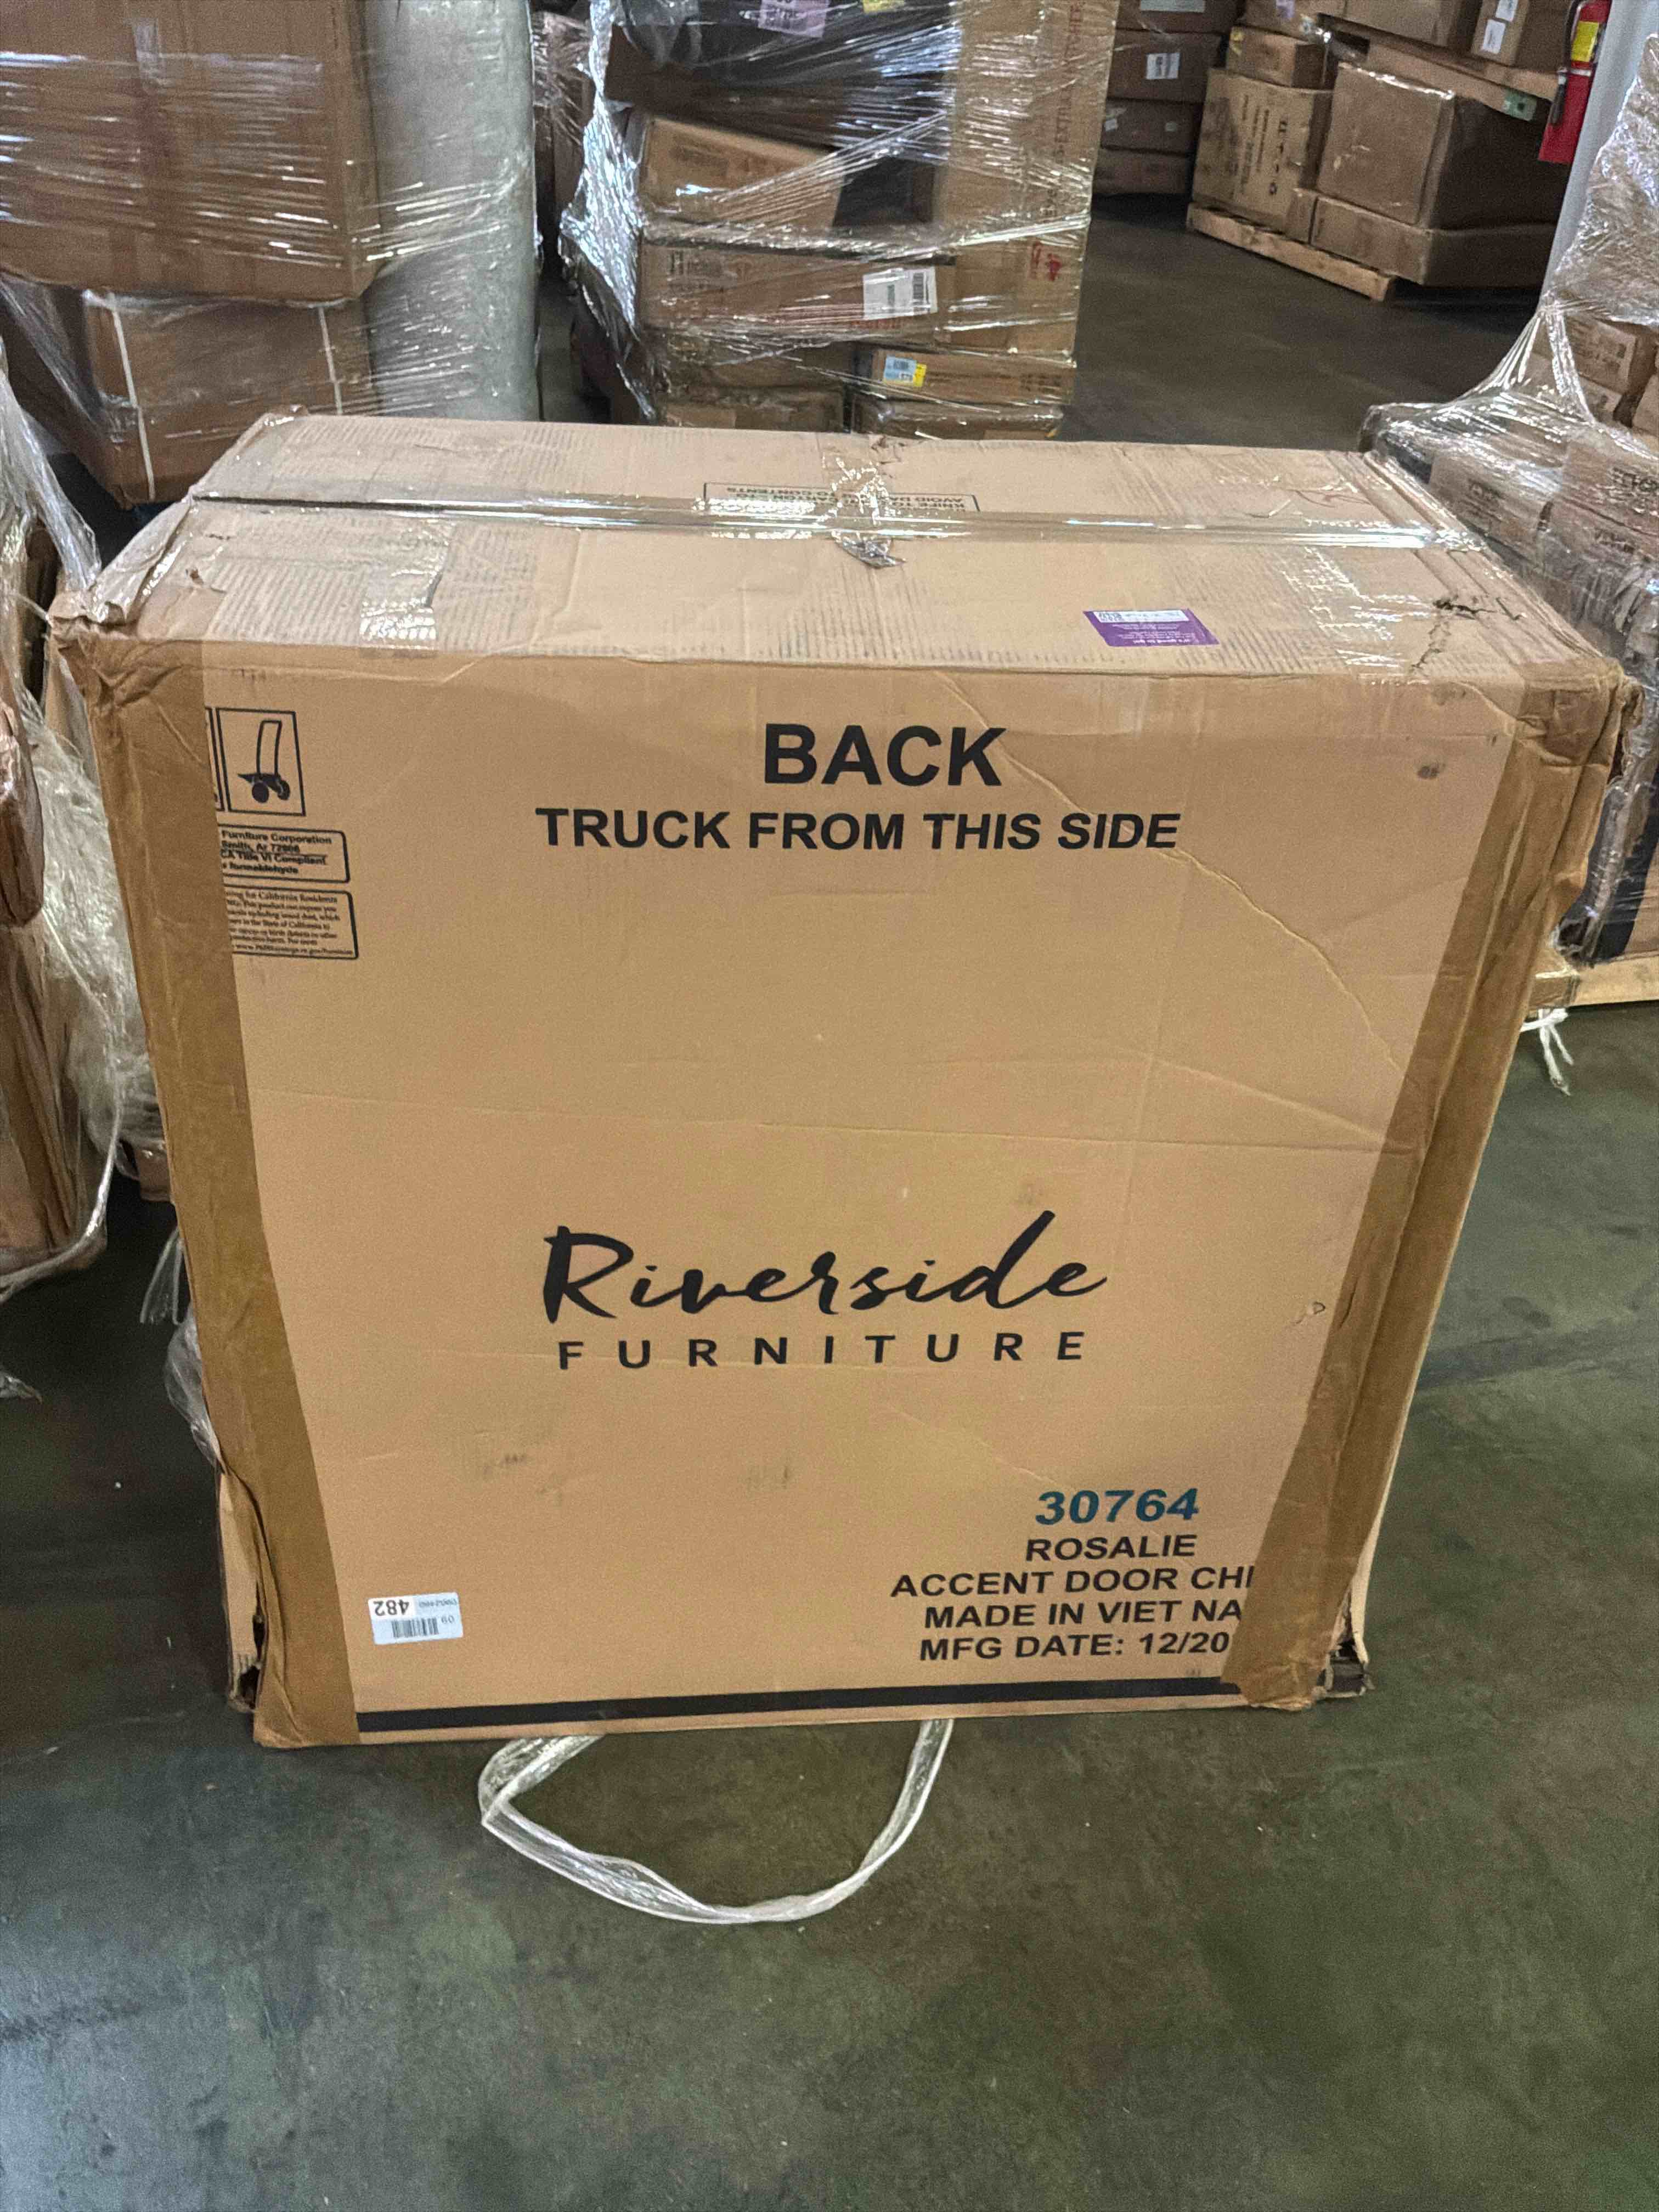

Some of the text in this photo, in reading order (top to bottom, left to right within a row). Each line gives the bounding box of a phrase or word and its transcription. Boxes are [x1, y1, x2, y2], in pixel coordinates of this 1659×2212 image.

[765, 723, 1006, 787] BACK
[271, 833, 332, 844] Corporation
[535, 807, 1181, 850] TRUCK FROM THIS SIDE
[543, 1209, 1107, 1324] Riverside
[558, 1331, 1085, 1370] FURNITURE
[1035, 1487, 1199, 1526] 30764
[1025, 1534, 1198, 1562] ROSALIE
[891, 1571, 1054, 1597] ACCENT
[1065, 1567, 1178, 1593] DOOR
[373, 1599, 410, 1617] 482
[924, 1604, 1036, 1628] MADE
[1048, 1603, 1085, 1625] IN
[1098, 1600, 1182, 1624] VIET
[919, 1638, 1002, 1661] MFG
[1015, 1634, 1124, 1658] DATE:
